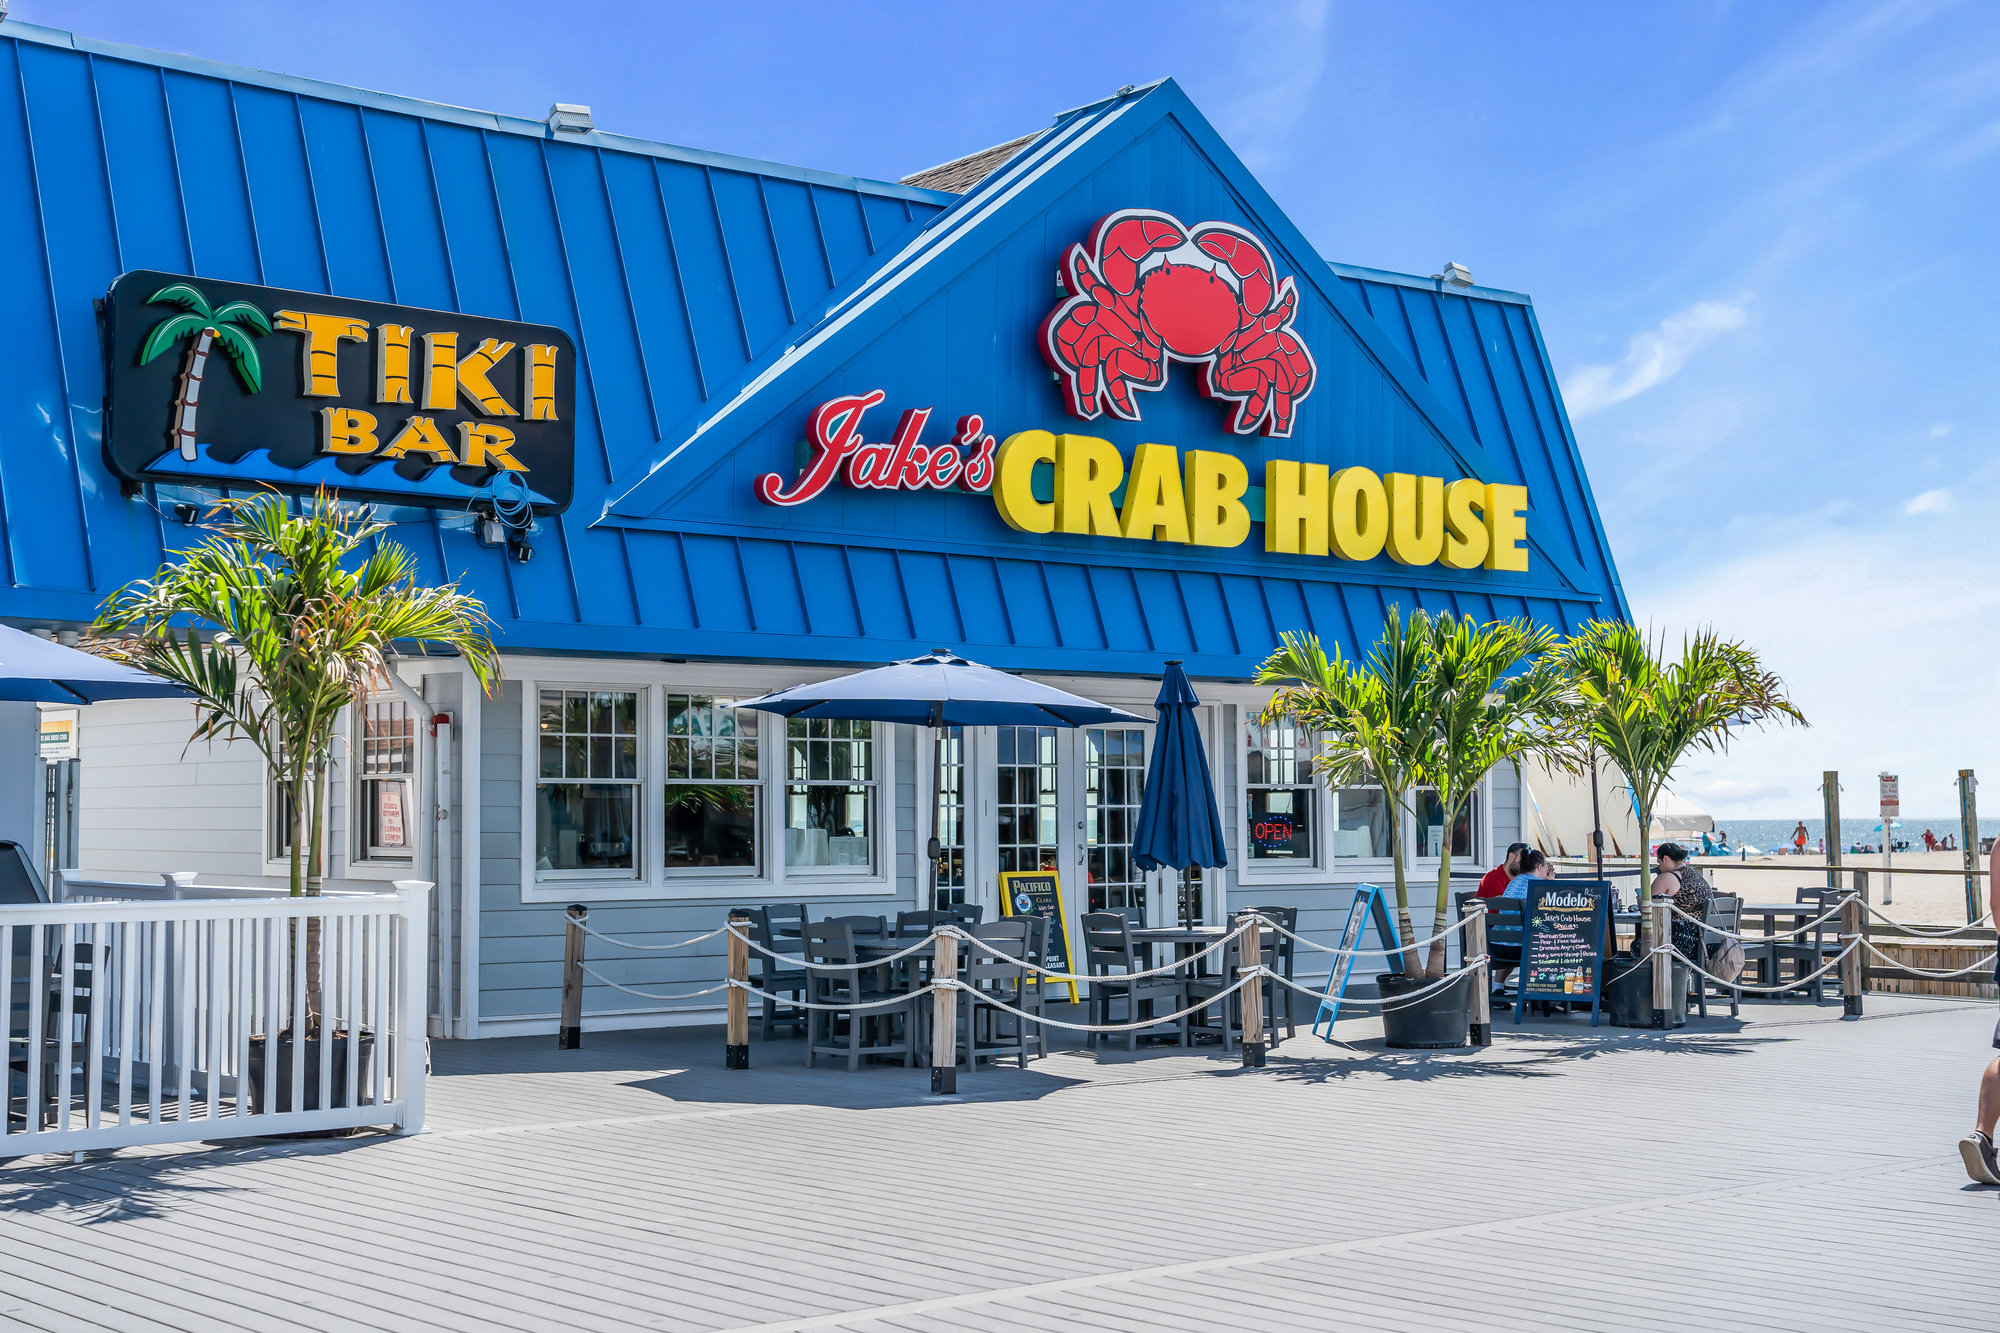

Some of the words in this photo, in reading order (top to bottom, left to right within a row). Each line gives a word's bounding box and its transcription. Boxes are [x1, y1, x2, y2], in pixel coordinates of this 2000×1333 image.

[273, 310, 559, 421] TIKI
[319, 407, 531, 472] BAR
[754, 387, 997, 507] Jake's
[992, 429, 1251, 548] CRAB
[1264, 457, 1528, 573] HOUSE
[1255, 823, 1292, 840] OPEN
[1013, 880, 1051, 893] PACIFICO
[1545, 892, 1587, 907] Modelo
[1560, 913, 1573, 922] Crab
[1573, 914, 1592, 922] House
